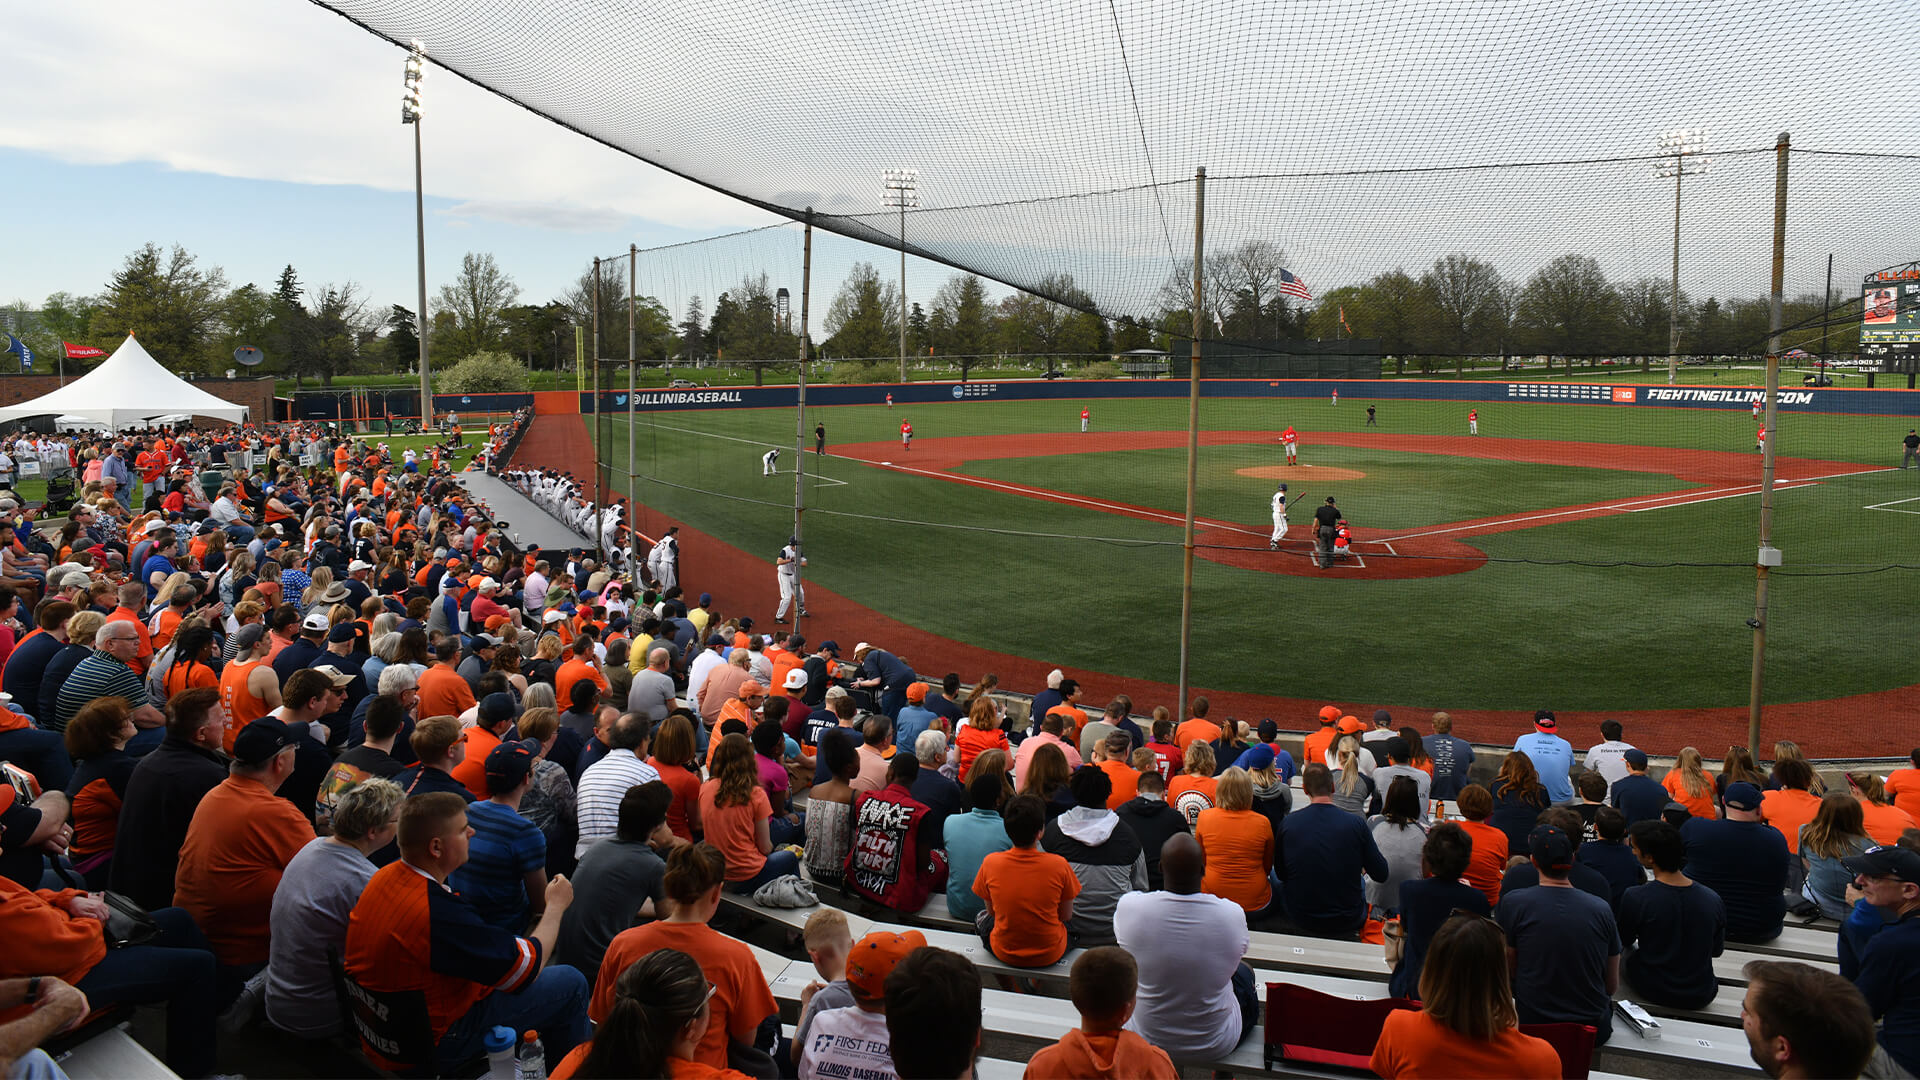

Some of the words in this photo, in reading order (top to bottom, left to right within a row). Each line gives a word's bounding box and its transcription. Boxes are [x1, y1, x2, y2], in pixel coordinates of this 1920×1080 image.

[634, 391, 742, 405] @ILLINIBASEBALL
[1647, 389, 1813, 404] FIGHTINGILLINICOM
[858, 833, 897, 855] FILTH
[835, 1035, 865, 1051] FIRST
[817, 1061, 852, 1077] ILLINOIS
[853, 1067, 893, 1080] BASEBALL
